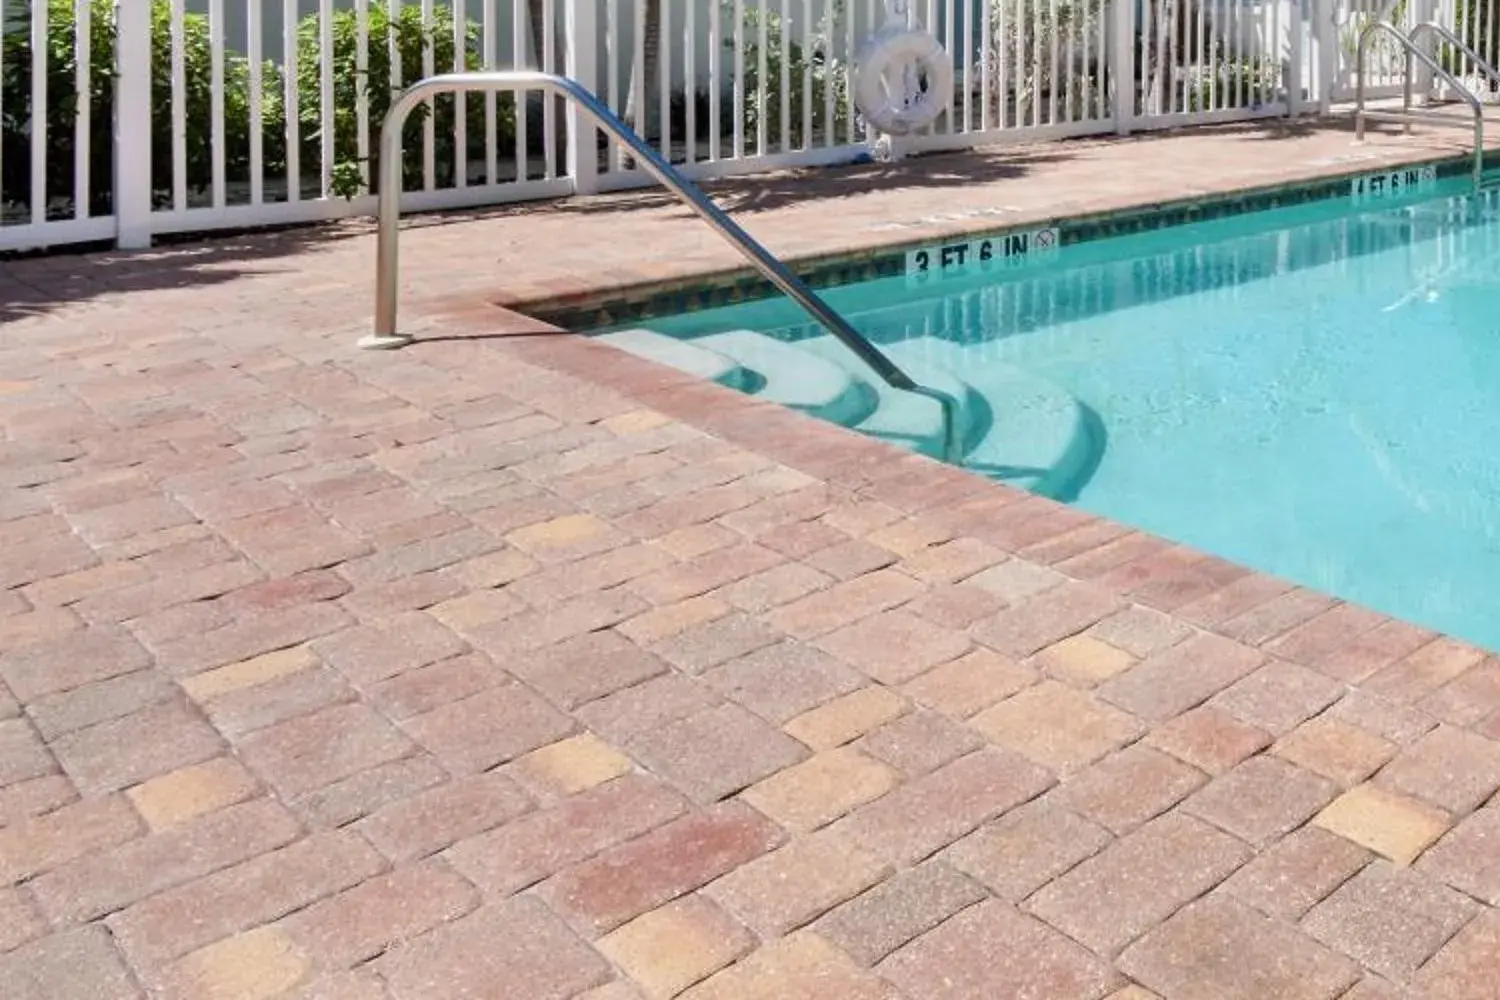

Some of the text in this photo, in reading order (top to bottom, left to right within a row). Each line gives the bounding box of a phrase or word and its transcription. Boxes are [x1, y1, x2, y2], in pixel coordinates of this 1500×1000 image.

[1370, 175, 1386, 190] FT
[1405, 170, 1419, 185] IN
[941, 244, 968, 268] FT
[979, 240, 993, 260] 6
[1005, 234, 1028, 256] IN
